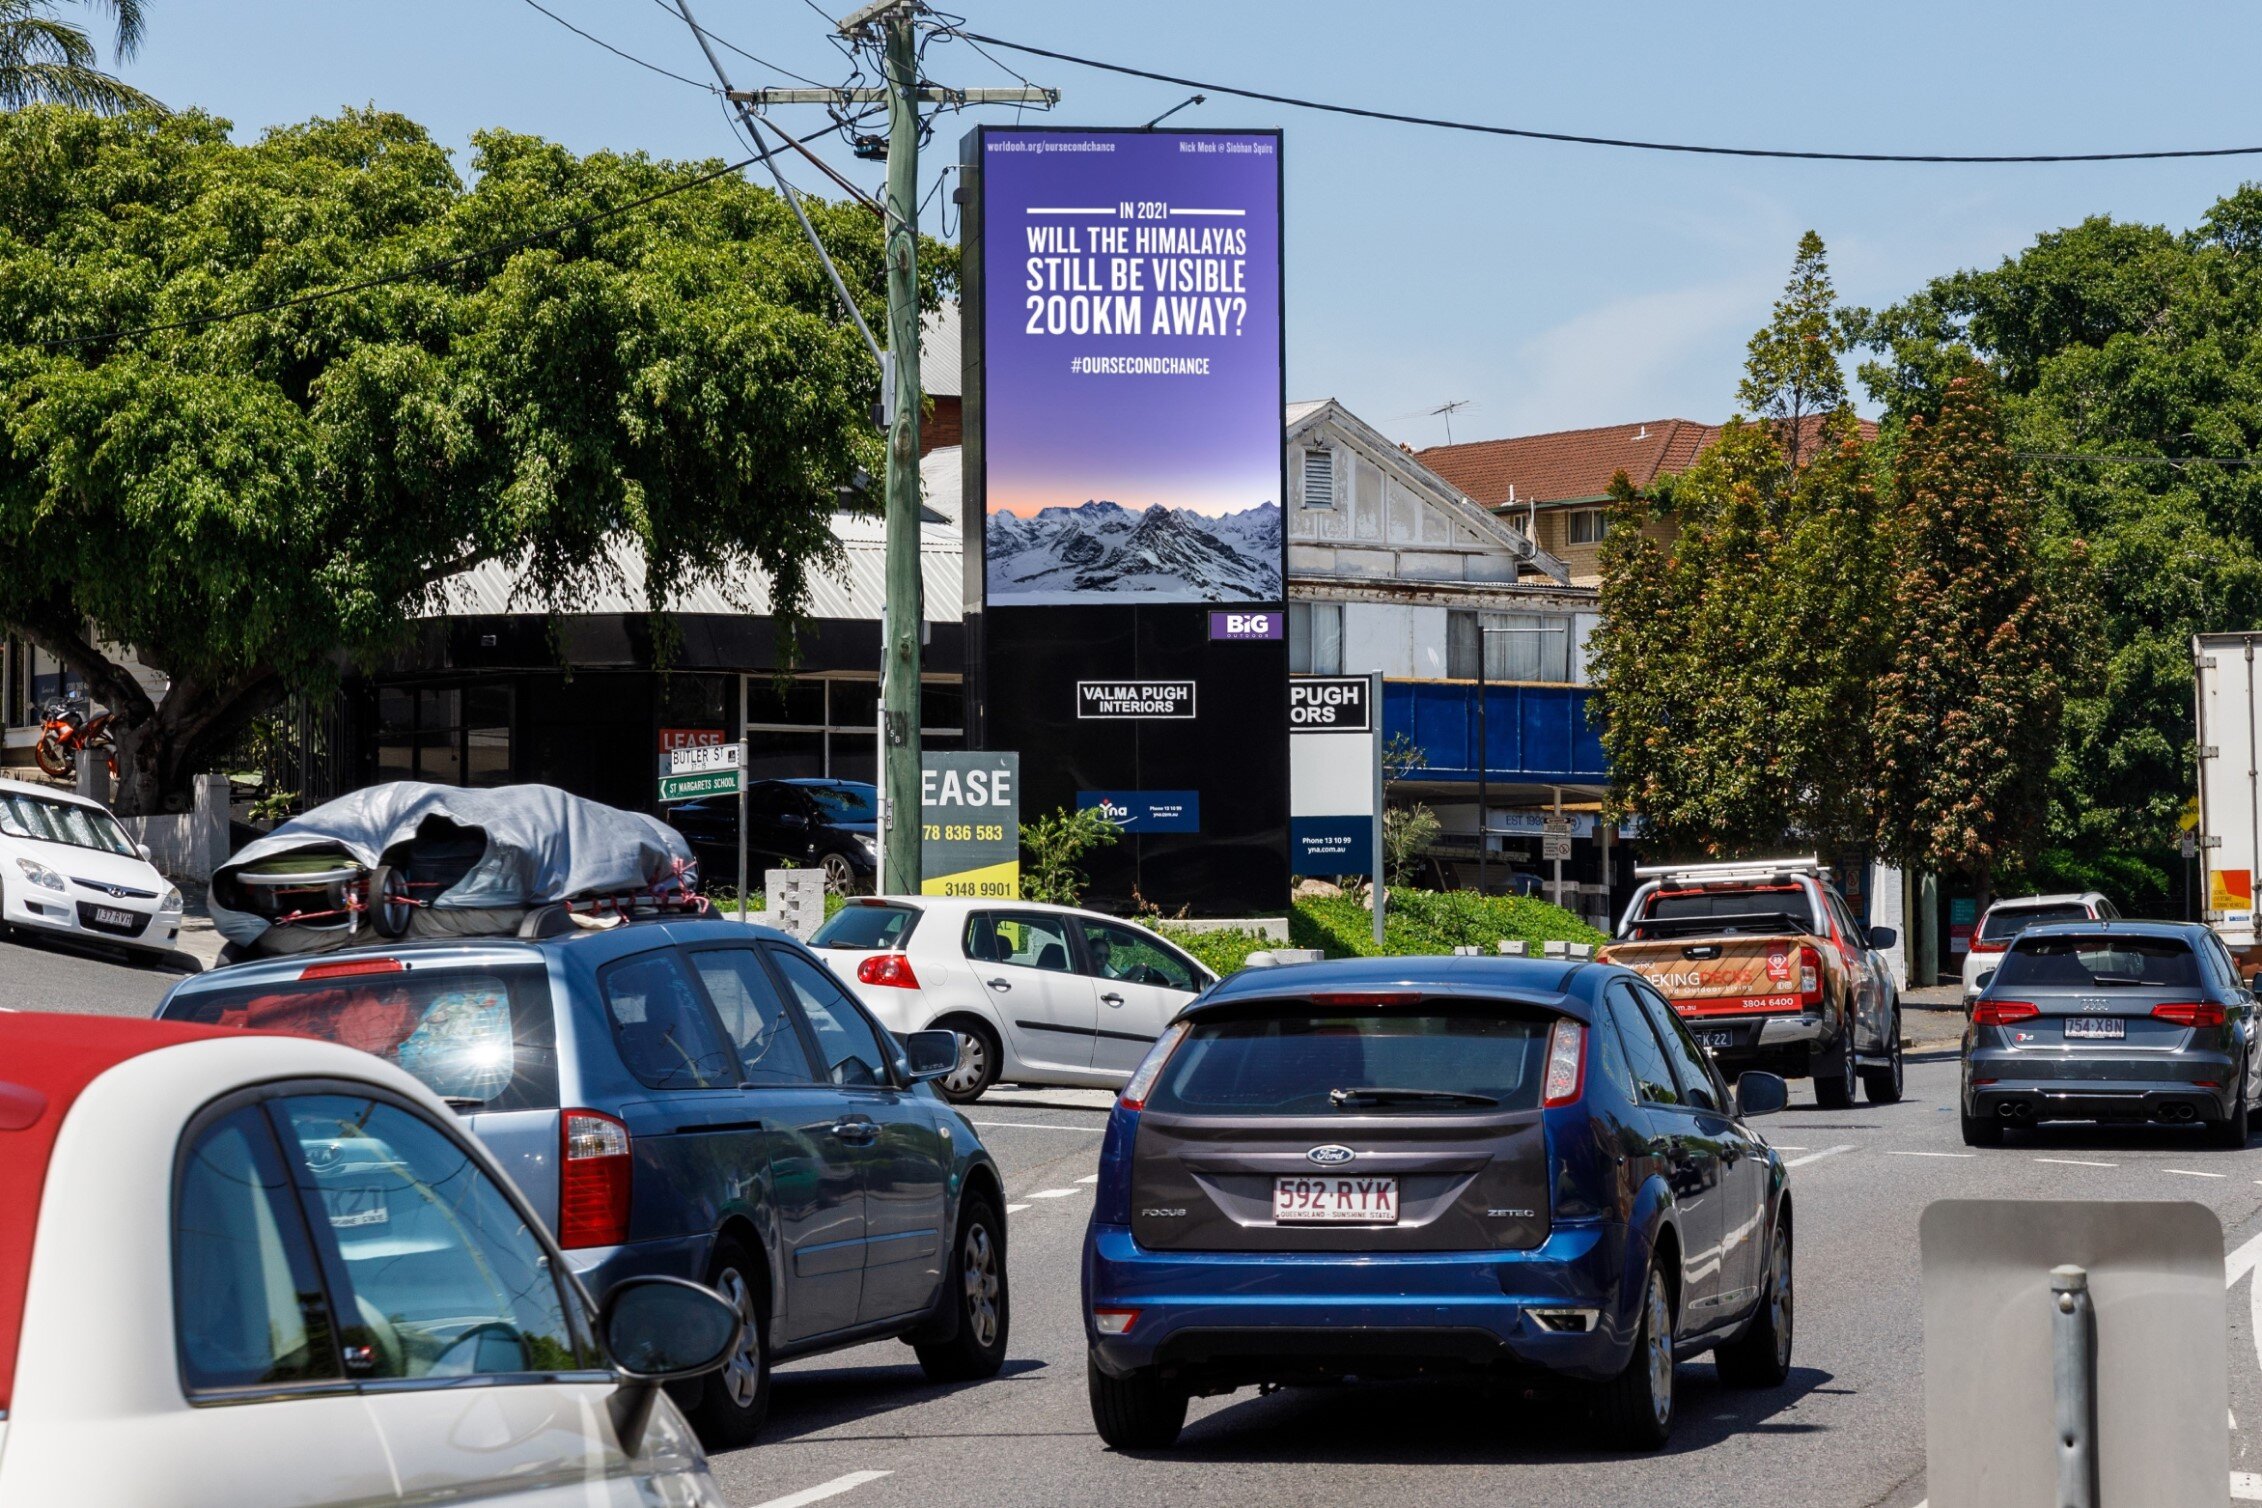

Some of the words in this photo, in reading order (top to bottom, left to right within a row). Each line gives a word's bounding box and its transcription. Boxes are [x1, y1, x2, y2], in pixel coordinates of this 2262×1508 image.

[987, 140, 1115, 154] worldooh.org/oursecondchance
[1180, 141, 1196, 153] Nick
[1226, 142, 1252, 154] Siobhan
[1253, 143, 1273, 155] Squire
[1120, 202, 1134, 219] IN
[1138, 202, 1168, 219] 2021
[1026, 227, 1081, 253] WILL
[1087, 227, 1129, 253] THE
[1136, 228, 1247, 255] HIMALAYAS
[1026, 257, 1102, 291] STILL
[1111, 258, 1144, 292] BE
[1151, 259, 1246, 293] VISIBLE
[1025, 295, 1141, 335] 200KM
[1151, 297, 1247, 336] AWAY?
[1071, 357, 1210, 375] #OURSECONDCHANCE
[1083, 686, 1138, 700] VALMA
[1142, 686, 1188, 700] PUGH
[1291, 686, 1359, 706] PUGH
[1099, 700, 1174, 713] INTERIORS
[664, 733, 720, 751] LEASE
[673, 749, 709, 765] BUTLER
[713, 747, 723, 761] ST
[670, 783, 677, 794] ST
[679, 780, 712, 793] MARGARETS
[714, 777, 736, 789] SCHOOL
[1505, 815, 1523, 826] EST
[944, 824, 971, 841] 836
[976, 824, 1003, 841] 583
[1307, 846, 1346, 854] yna.com.au
[945, 882, 975, 897] 3148
[980, 882, 1011, 897] 9901
[1742, 999, 1767, 1008] 3804
[1769, 998, 1794, 1007] 6400
[1316, 1148, 1345, 1161] Ford
[1141, 1208, 1187, 1217] FOCUS
[1487, 1209, 1535, 1217] ZETEC
